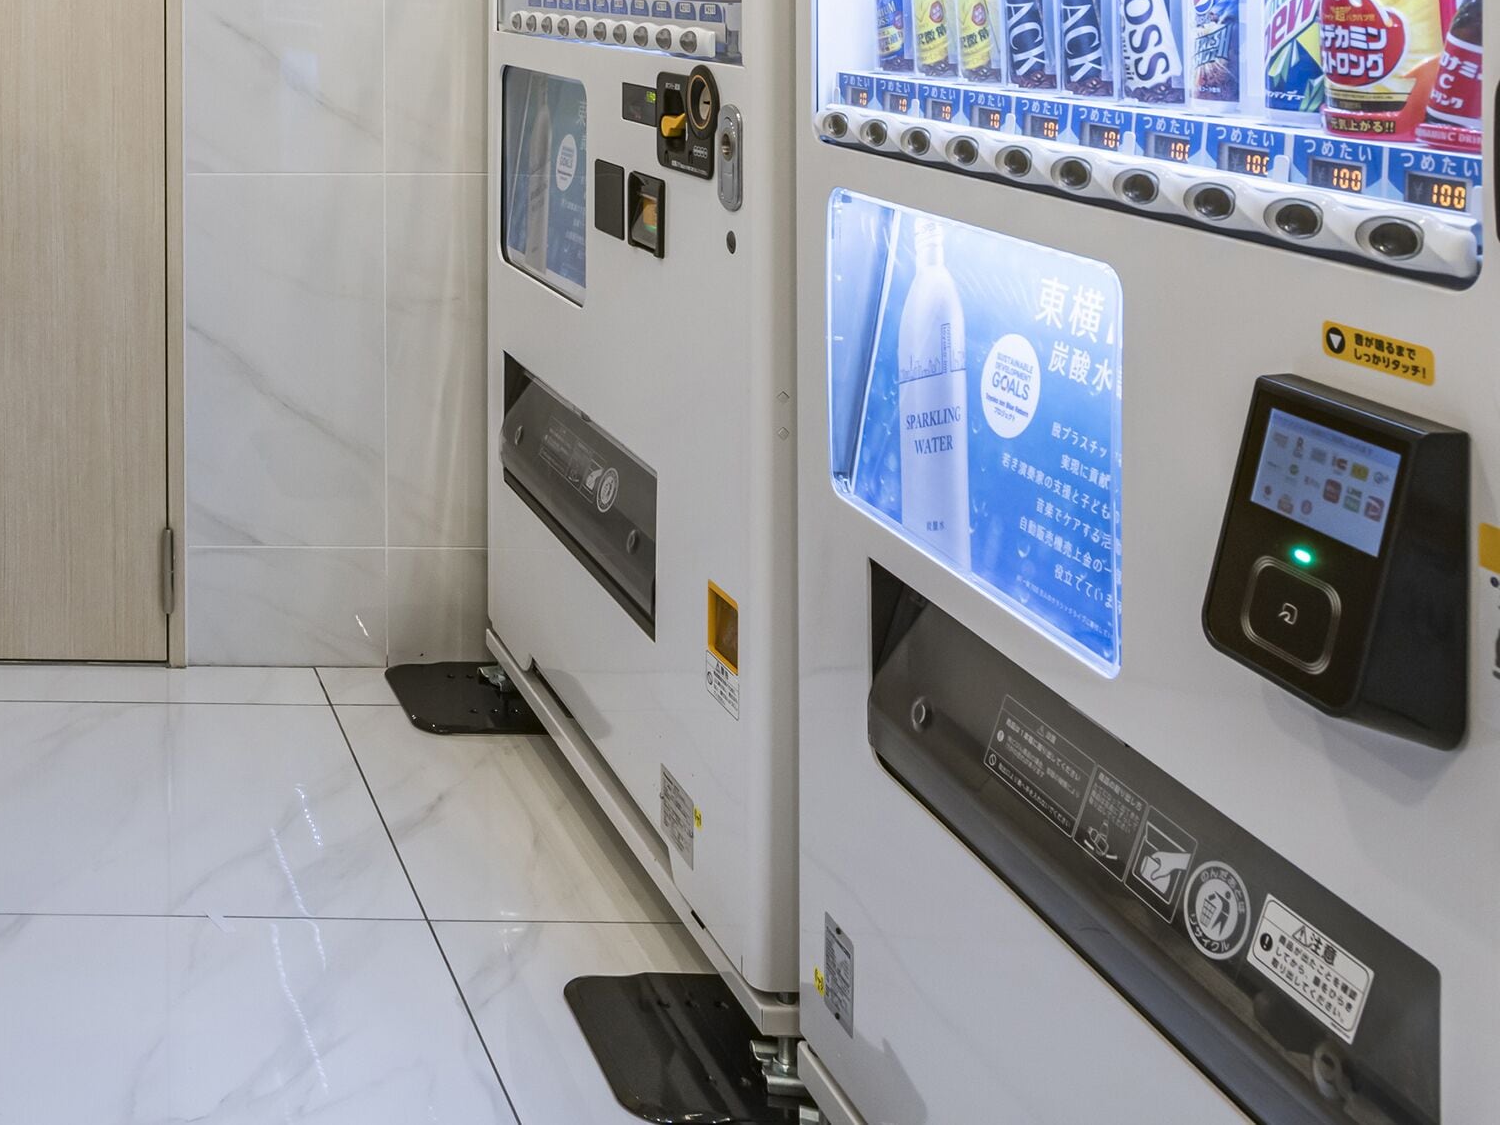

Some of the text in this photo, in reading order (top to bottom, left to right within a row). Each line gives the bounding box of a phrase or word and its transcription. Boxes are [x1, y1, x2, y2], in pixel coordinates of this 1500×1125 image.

[843, 74, 871, 89] つめたい
[880, 78, 911, 95] つめたい
[922, 84, 957, 101] つめたい
[1439, 75, 1455, 89] C
[968, 91, 1006, 108] つめたい
[1021, 99, 1063, 117] つめたい
[1079, 106, 1125, 125] つめたい
[1142, 115, 1195, 136] つめたい
[1330, 119, 1396, 134] 元気上がる!!
[1216, 125, 1276, 148] つめたい
[1303, 138, 1373, 162] つめたい
[1400, 151, 1480, 178] つめたい
[1332, 167, 1362, 192] 100
[1431, 183, 1467, 210] 100
[1353, 332, 1417, 361] 音が鳴るまで
[1048, 340, 1113, 392] 炭酸水
[1353, 347, 1428, 380] しっかりタッチ!
[992, 371, 1031, 402] GOALS
[906, 405, 962, 431] SPARKLING
[914, 434, 954, 456] WATER
[1309, 931, 1339, 967] 注意
